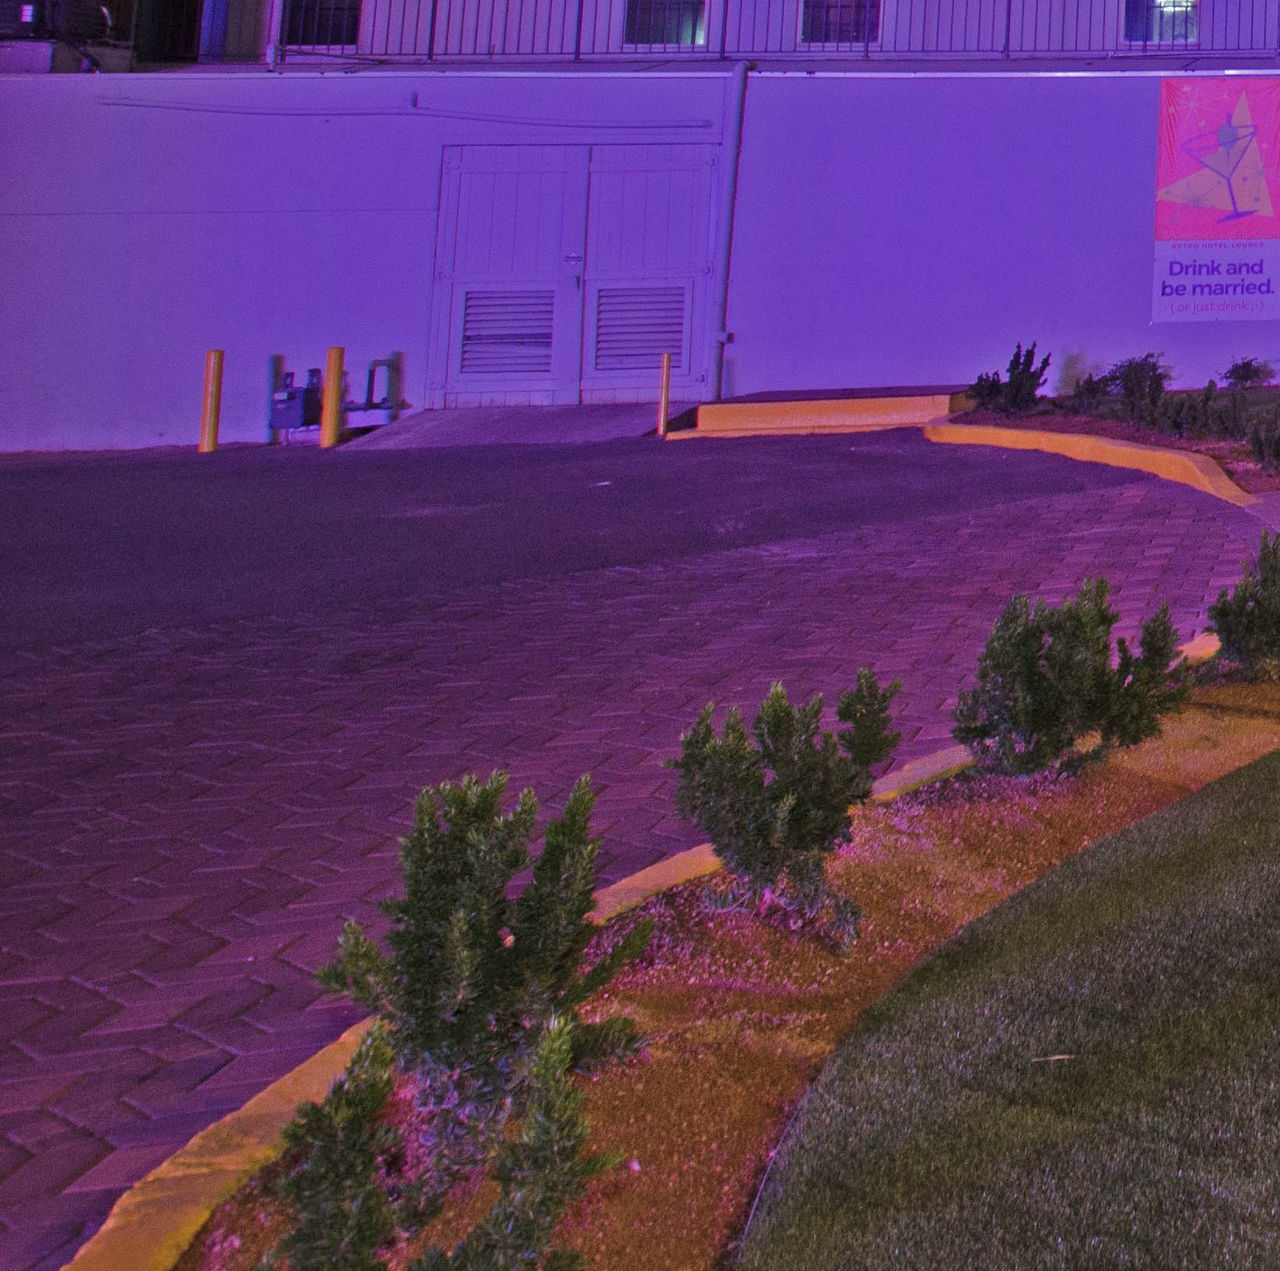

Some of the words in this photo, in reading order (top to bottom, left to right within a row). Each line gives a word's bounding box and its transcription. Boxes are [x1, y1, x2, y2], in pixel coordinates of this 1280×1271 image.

[1169, 259, 1221, 276] Drink
[1226, 258, 1264, 276] and
[1161, 280, 1187, 297] be
[1192, 278, 1275, 296] married.
[1192, 300, 1214, 315] just
[1217, 298, 1247, 312] drink
